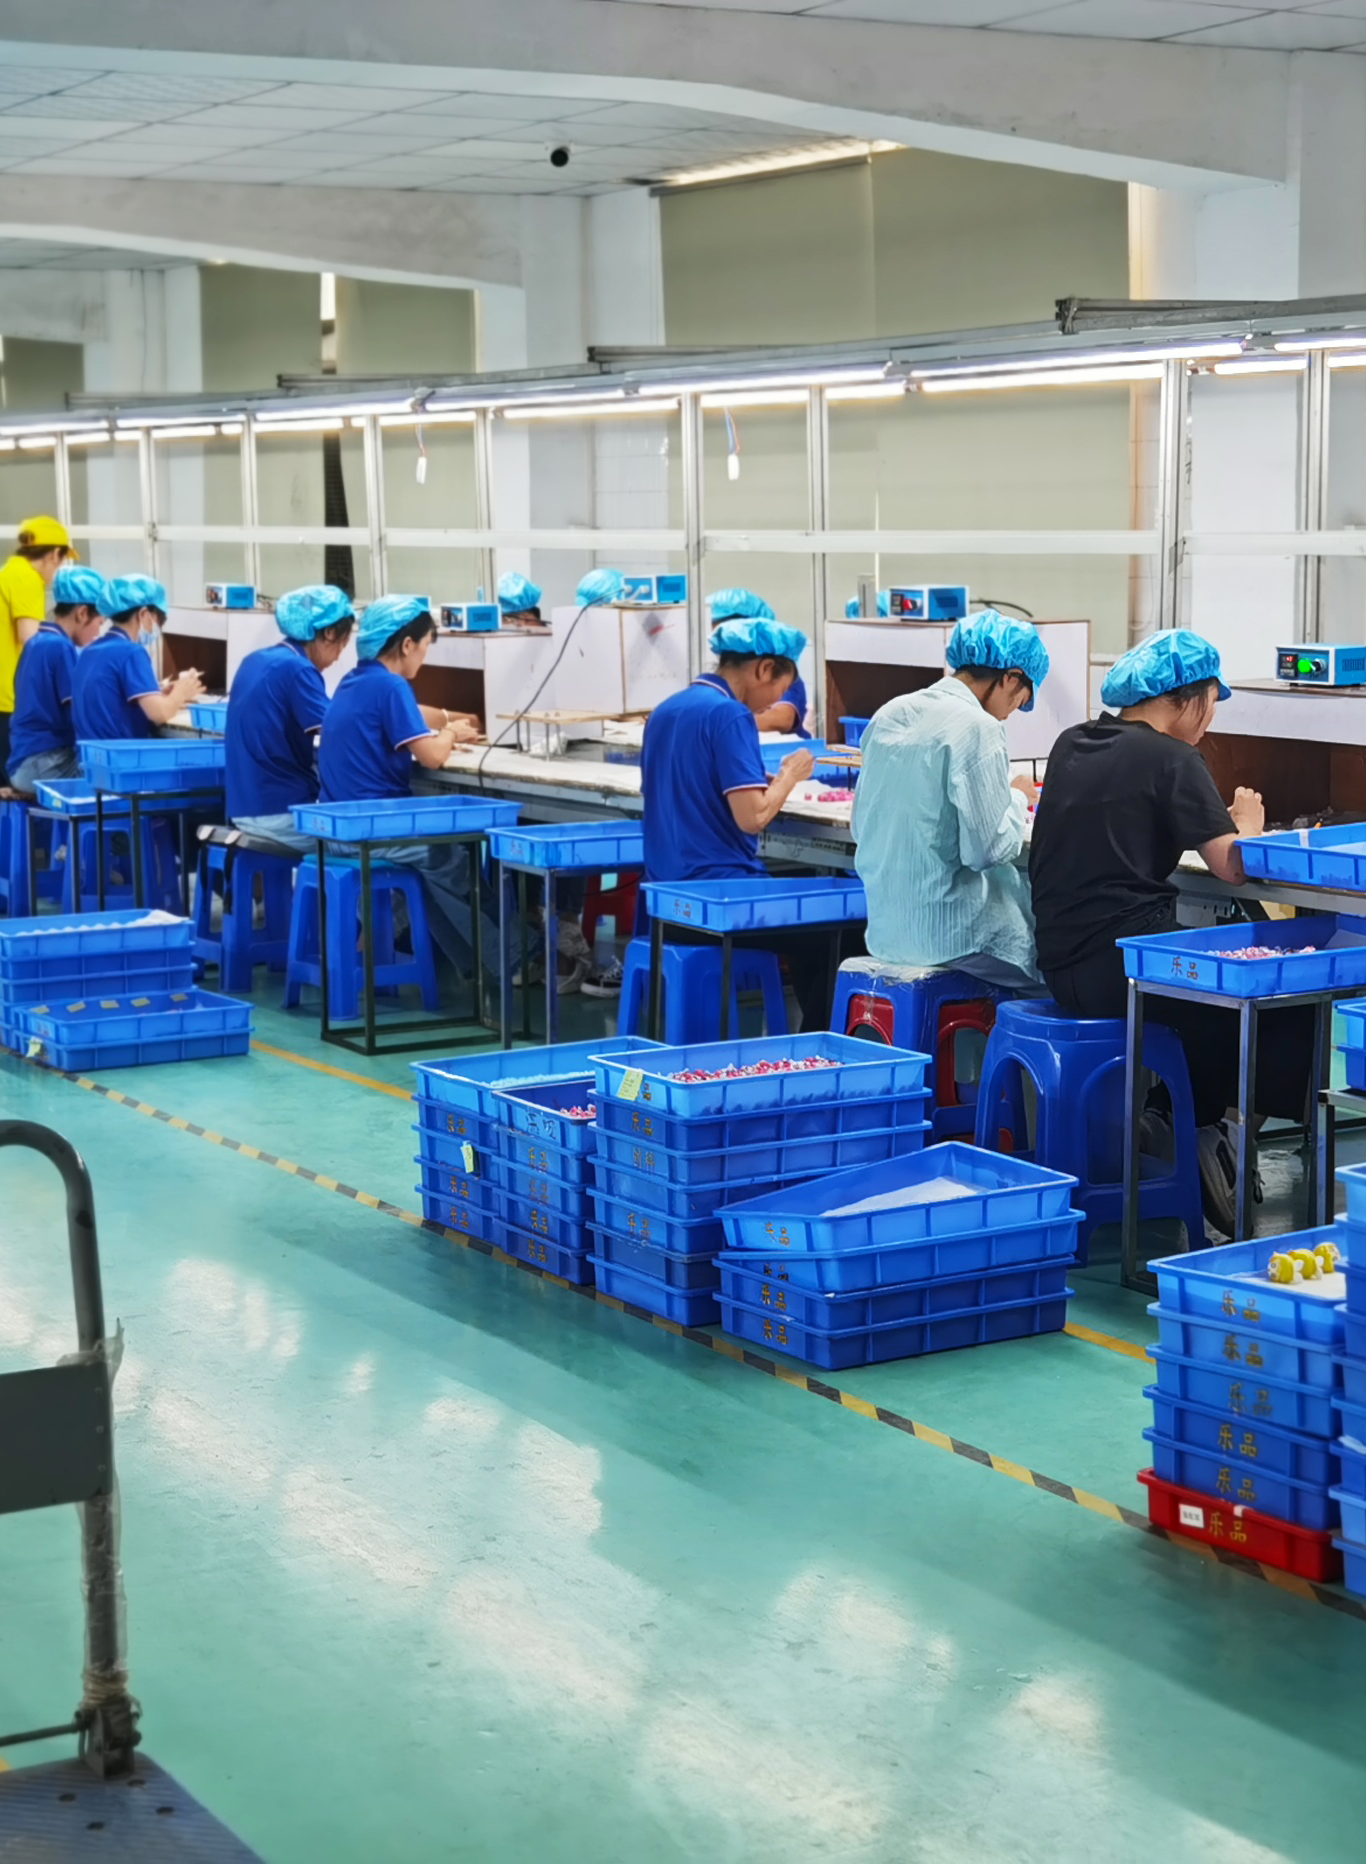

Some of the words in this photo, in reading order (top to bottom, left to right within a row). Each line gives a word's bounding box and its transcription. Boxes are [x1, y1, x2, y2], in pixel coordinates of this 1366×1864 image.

[1170, 956, 1198, 980] 乐品
[1221, 1289, 1261, 1322] 乐品
[1218, 1424, 1258, 1457] 乐品
[1216, 1467, 1256, 1501] 乐品
[1209, 1512, 1247, 1542] 乐品
